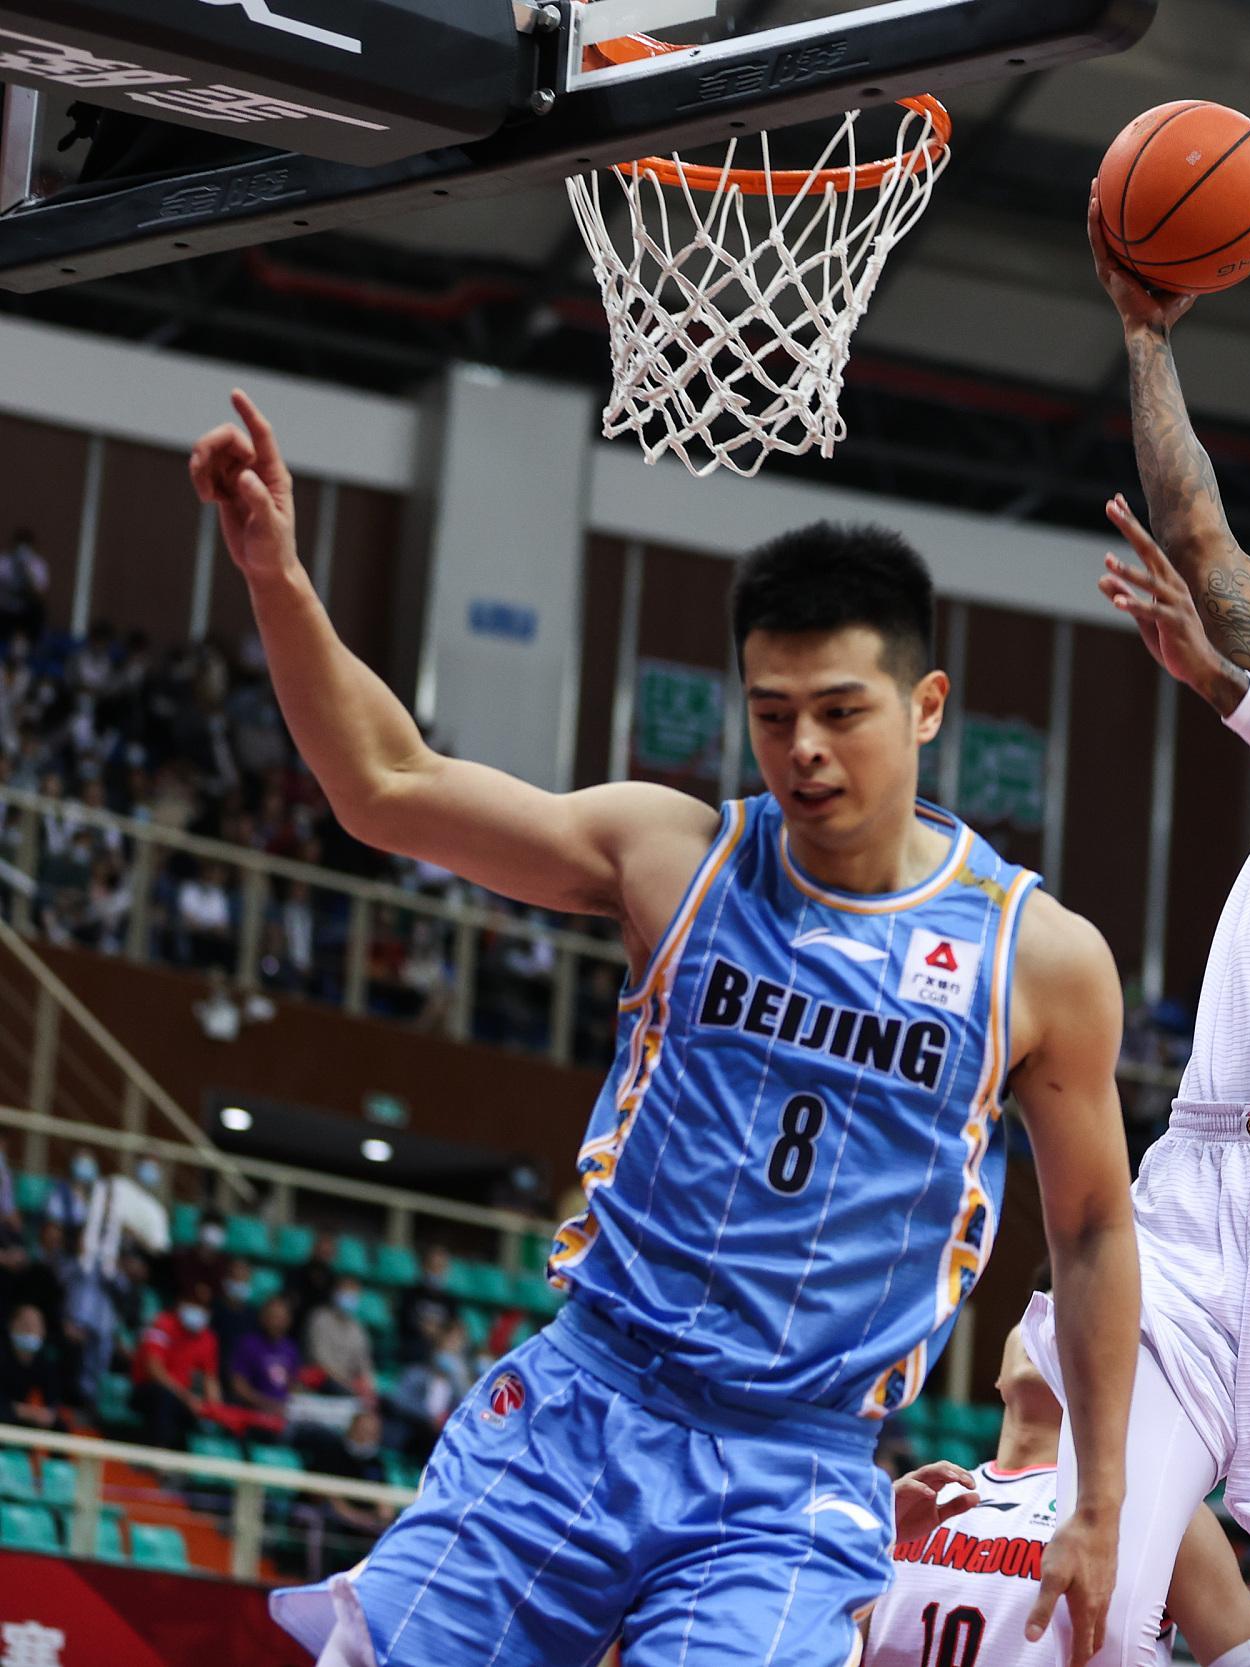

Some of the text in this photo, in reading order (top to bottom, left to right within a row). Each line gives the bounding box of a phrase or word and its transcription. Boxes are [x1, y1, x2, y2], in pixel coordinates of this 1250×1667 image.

[698, 955, 950, 1094] BEIJING
[764, 1091, 827, 1197] 8
[893, 1526, 1049, 1582] UANGDON
